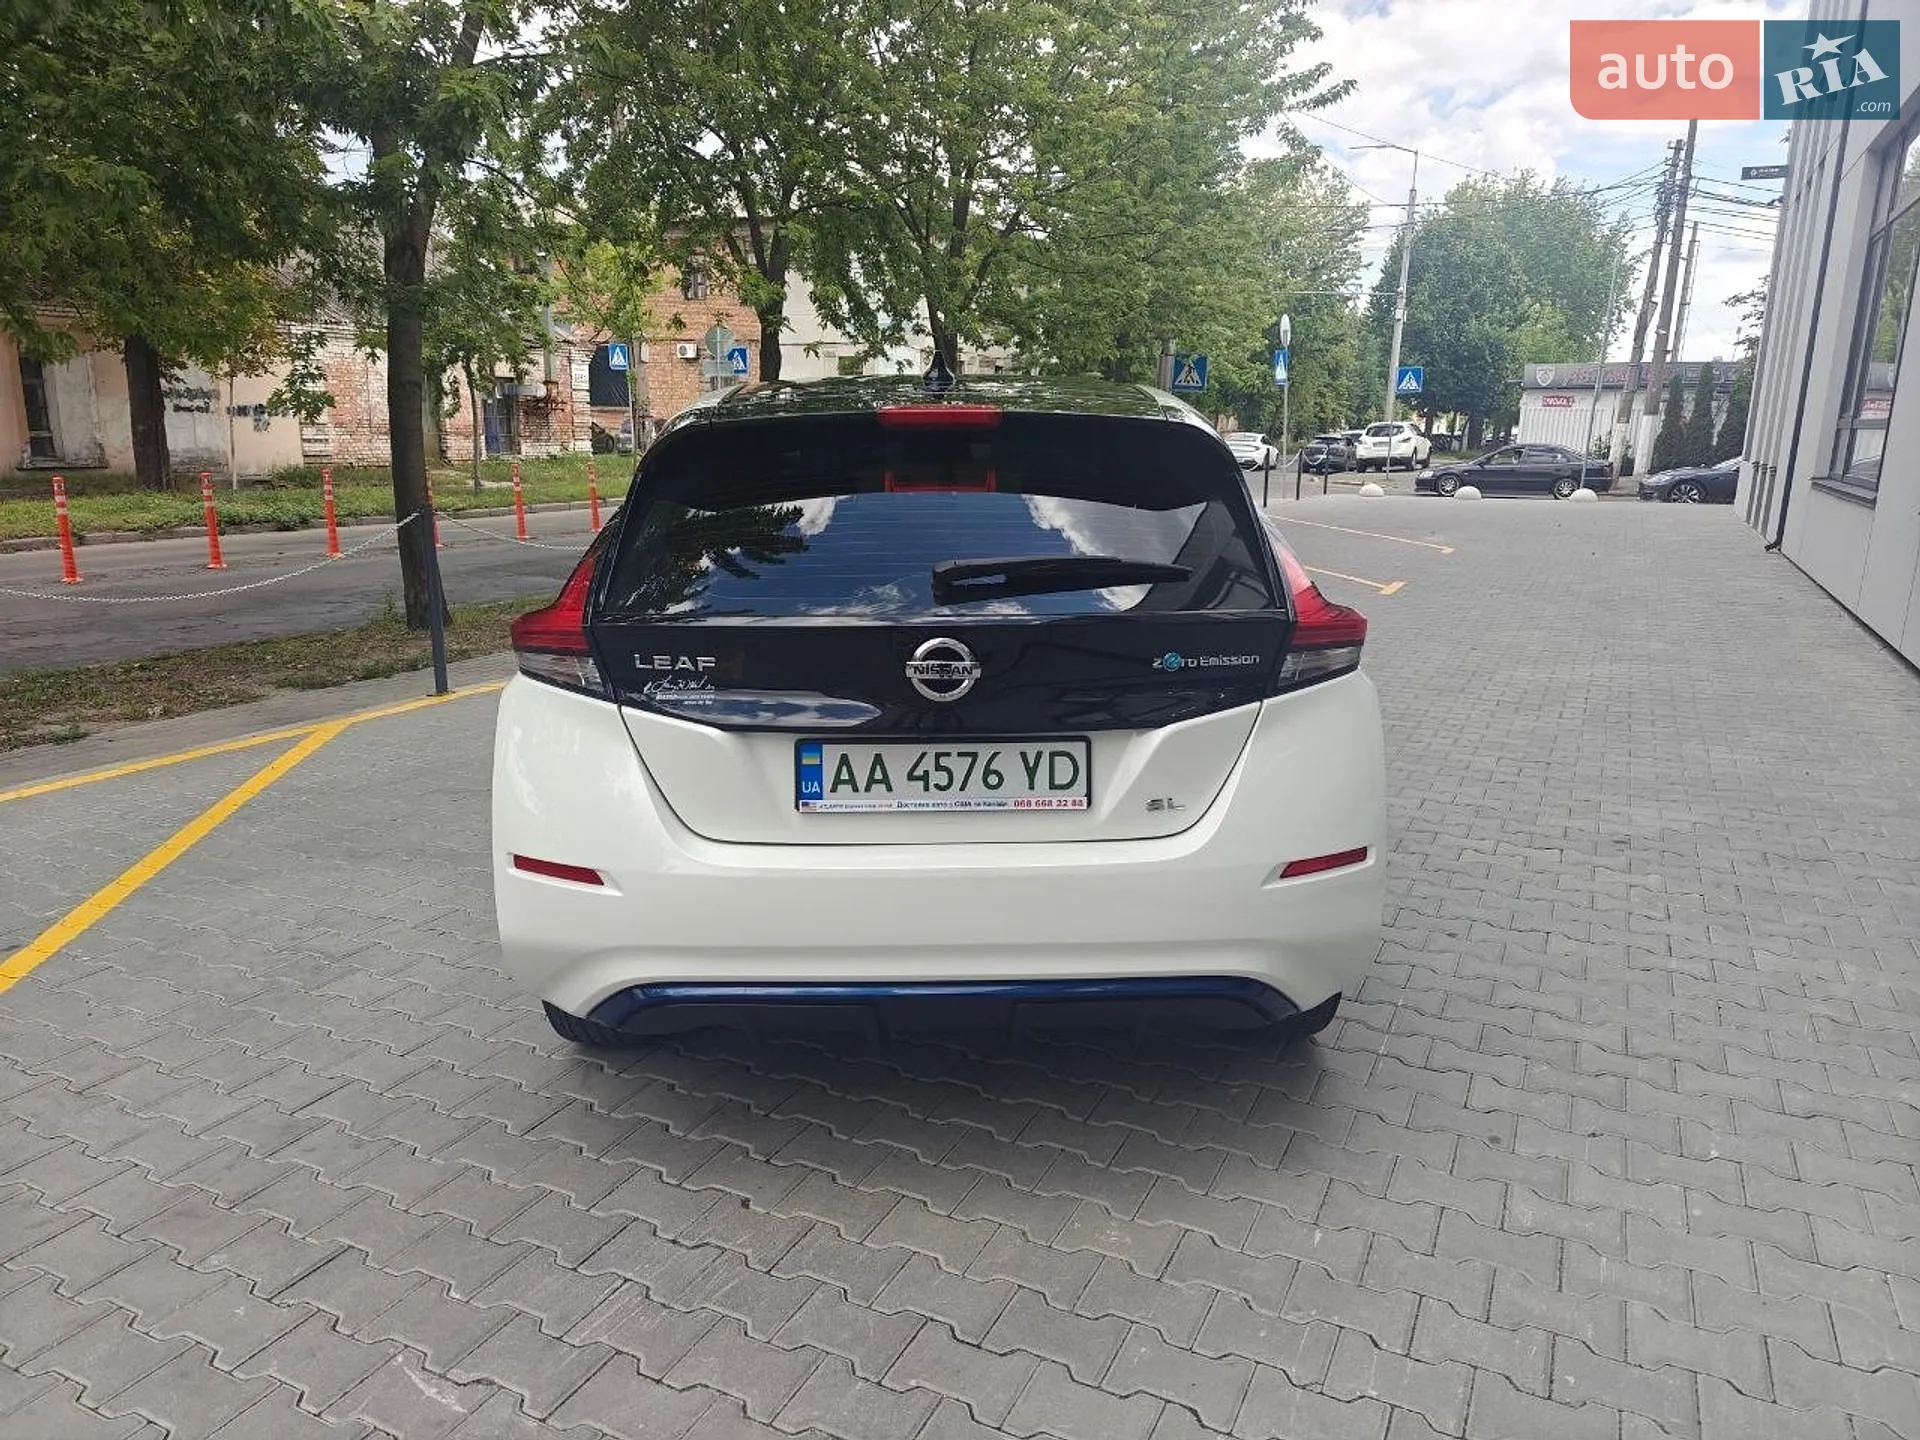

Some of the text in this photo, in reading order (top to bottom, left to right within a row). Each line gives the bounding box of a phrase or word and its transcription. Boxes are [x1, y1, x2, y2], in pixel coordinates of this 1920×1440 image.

[633, 654, 717, 671] LEAF
[1200, 655, 1260, 667] Emission
[913, 663, 974, 677] NISSAN
[829, 750, 1080, 793] AA 4576 YD
[802, 782, 821, 793] UA
